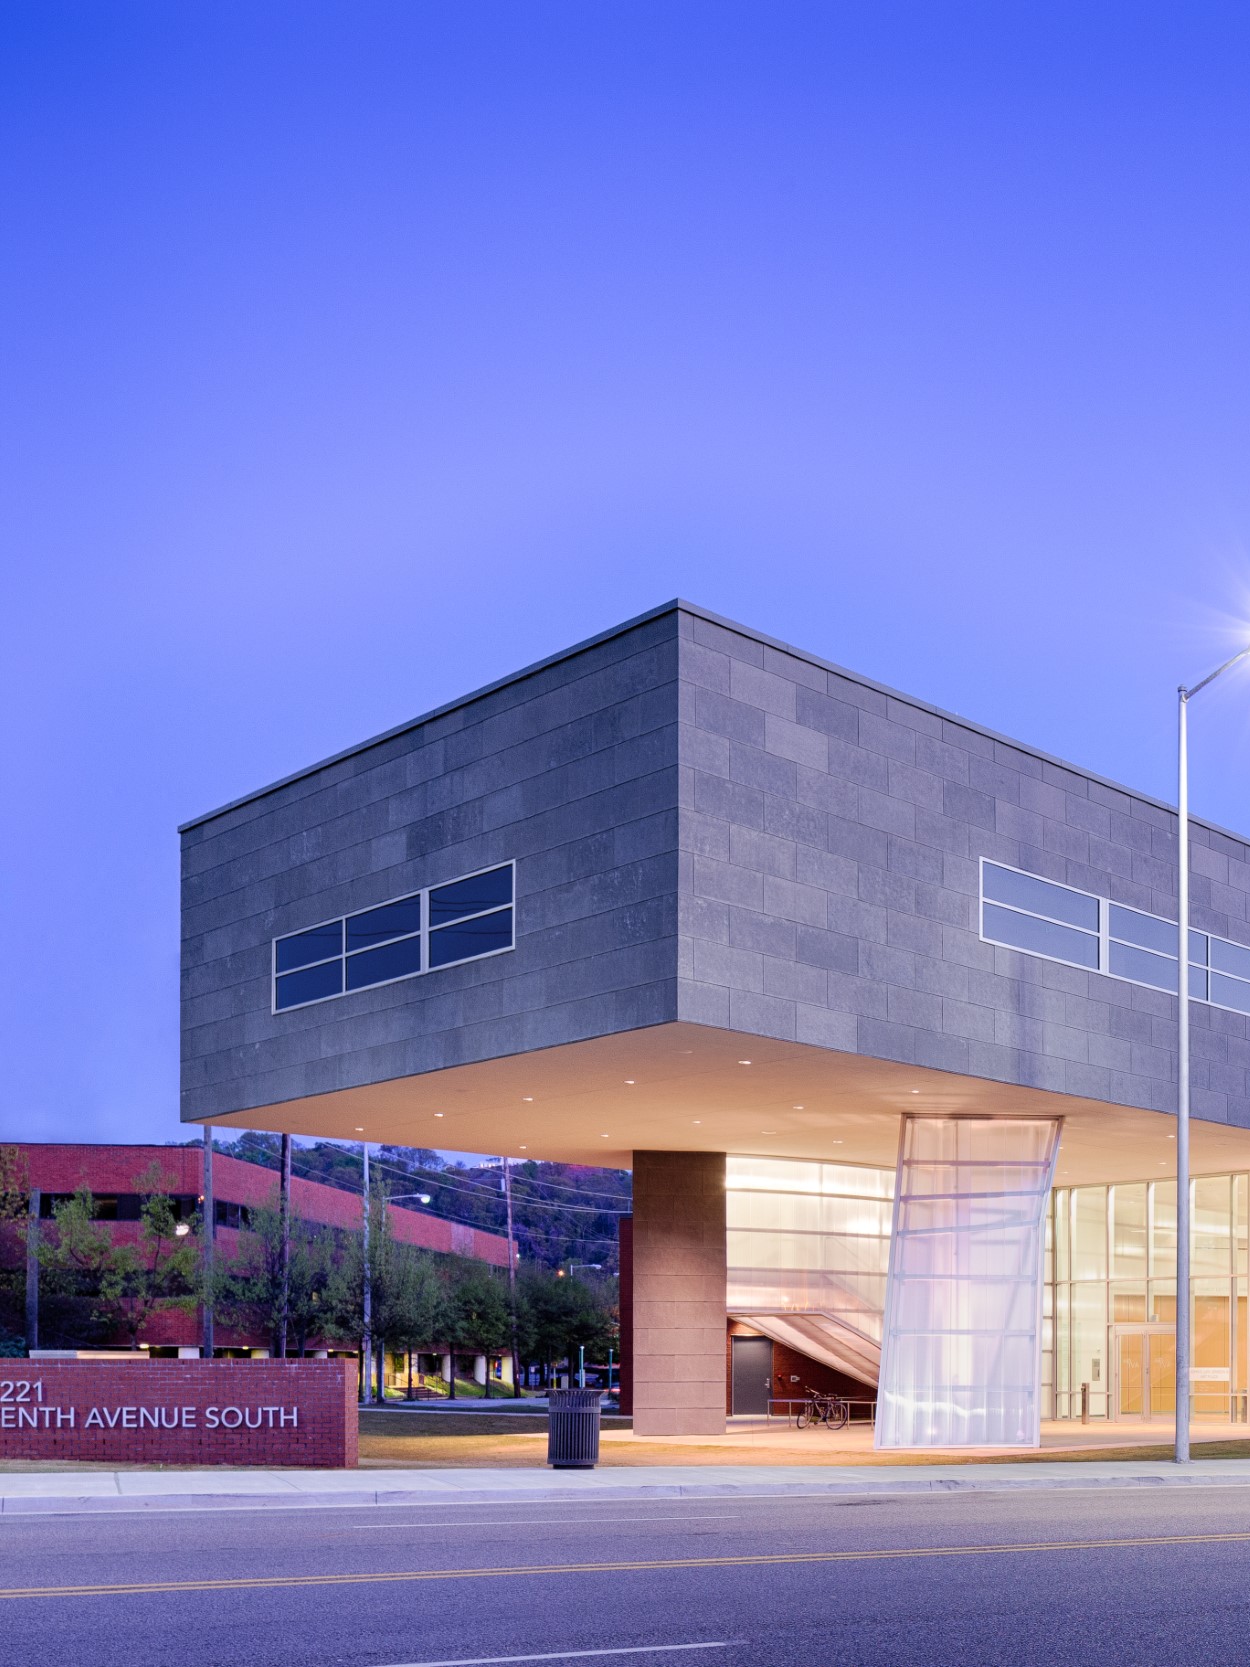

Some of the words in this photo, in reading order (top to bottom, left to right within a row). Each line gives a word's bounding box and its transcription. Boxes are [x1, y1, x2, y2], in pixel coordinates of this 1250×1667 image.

[0, 1381, 43, 1402] 221
[1, 1406, 75, 1428] ENTH
[84, 1406, 197, 1429] AVENUE
[205, 1406, 298, 1428] SOUTH
